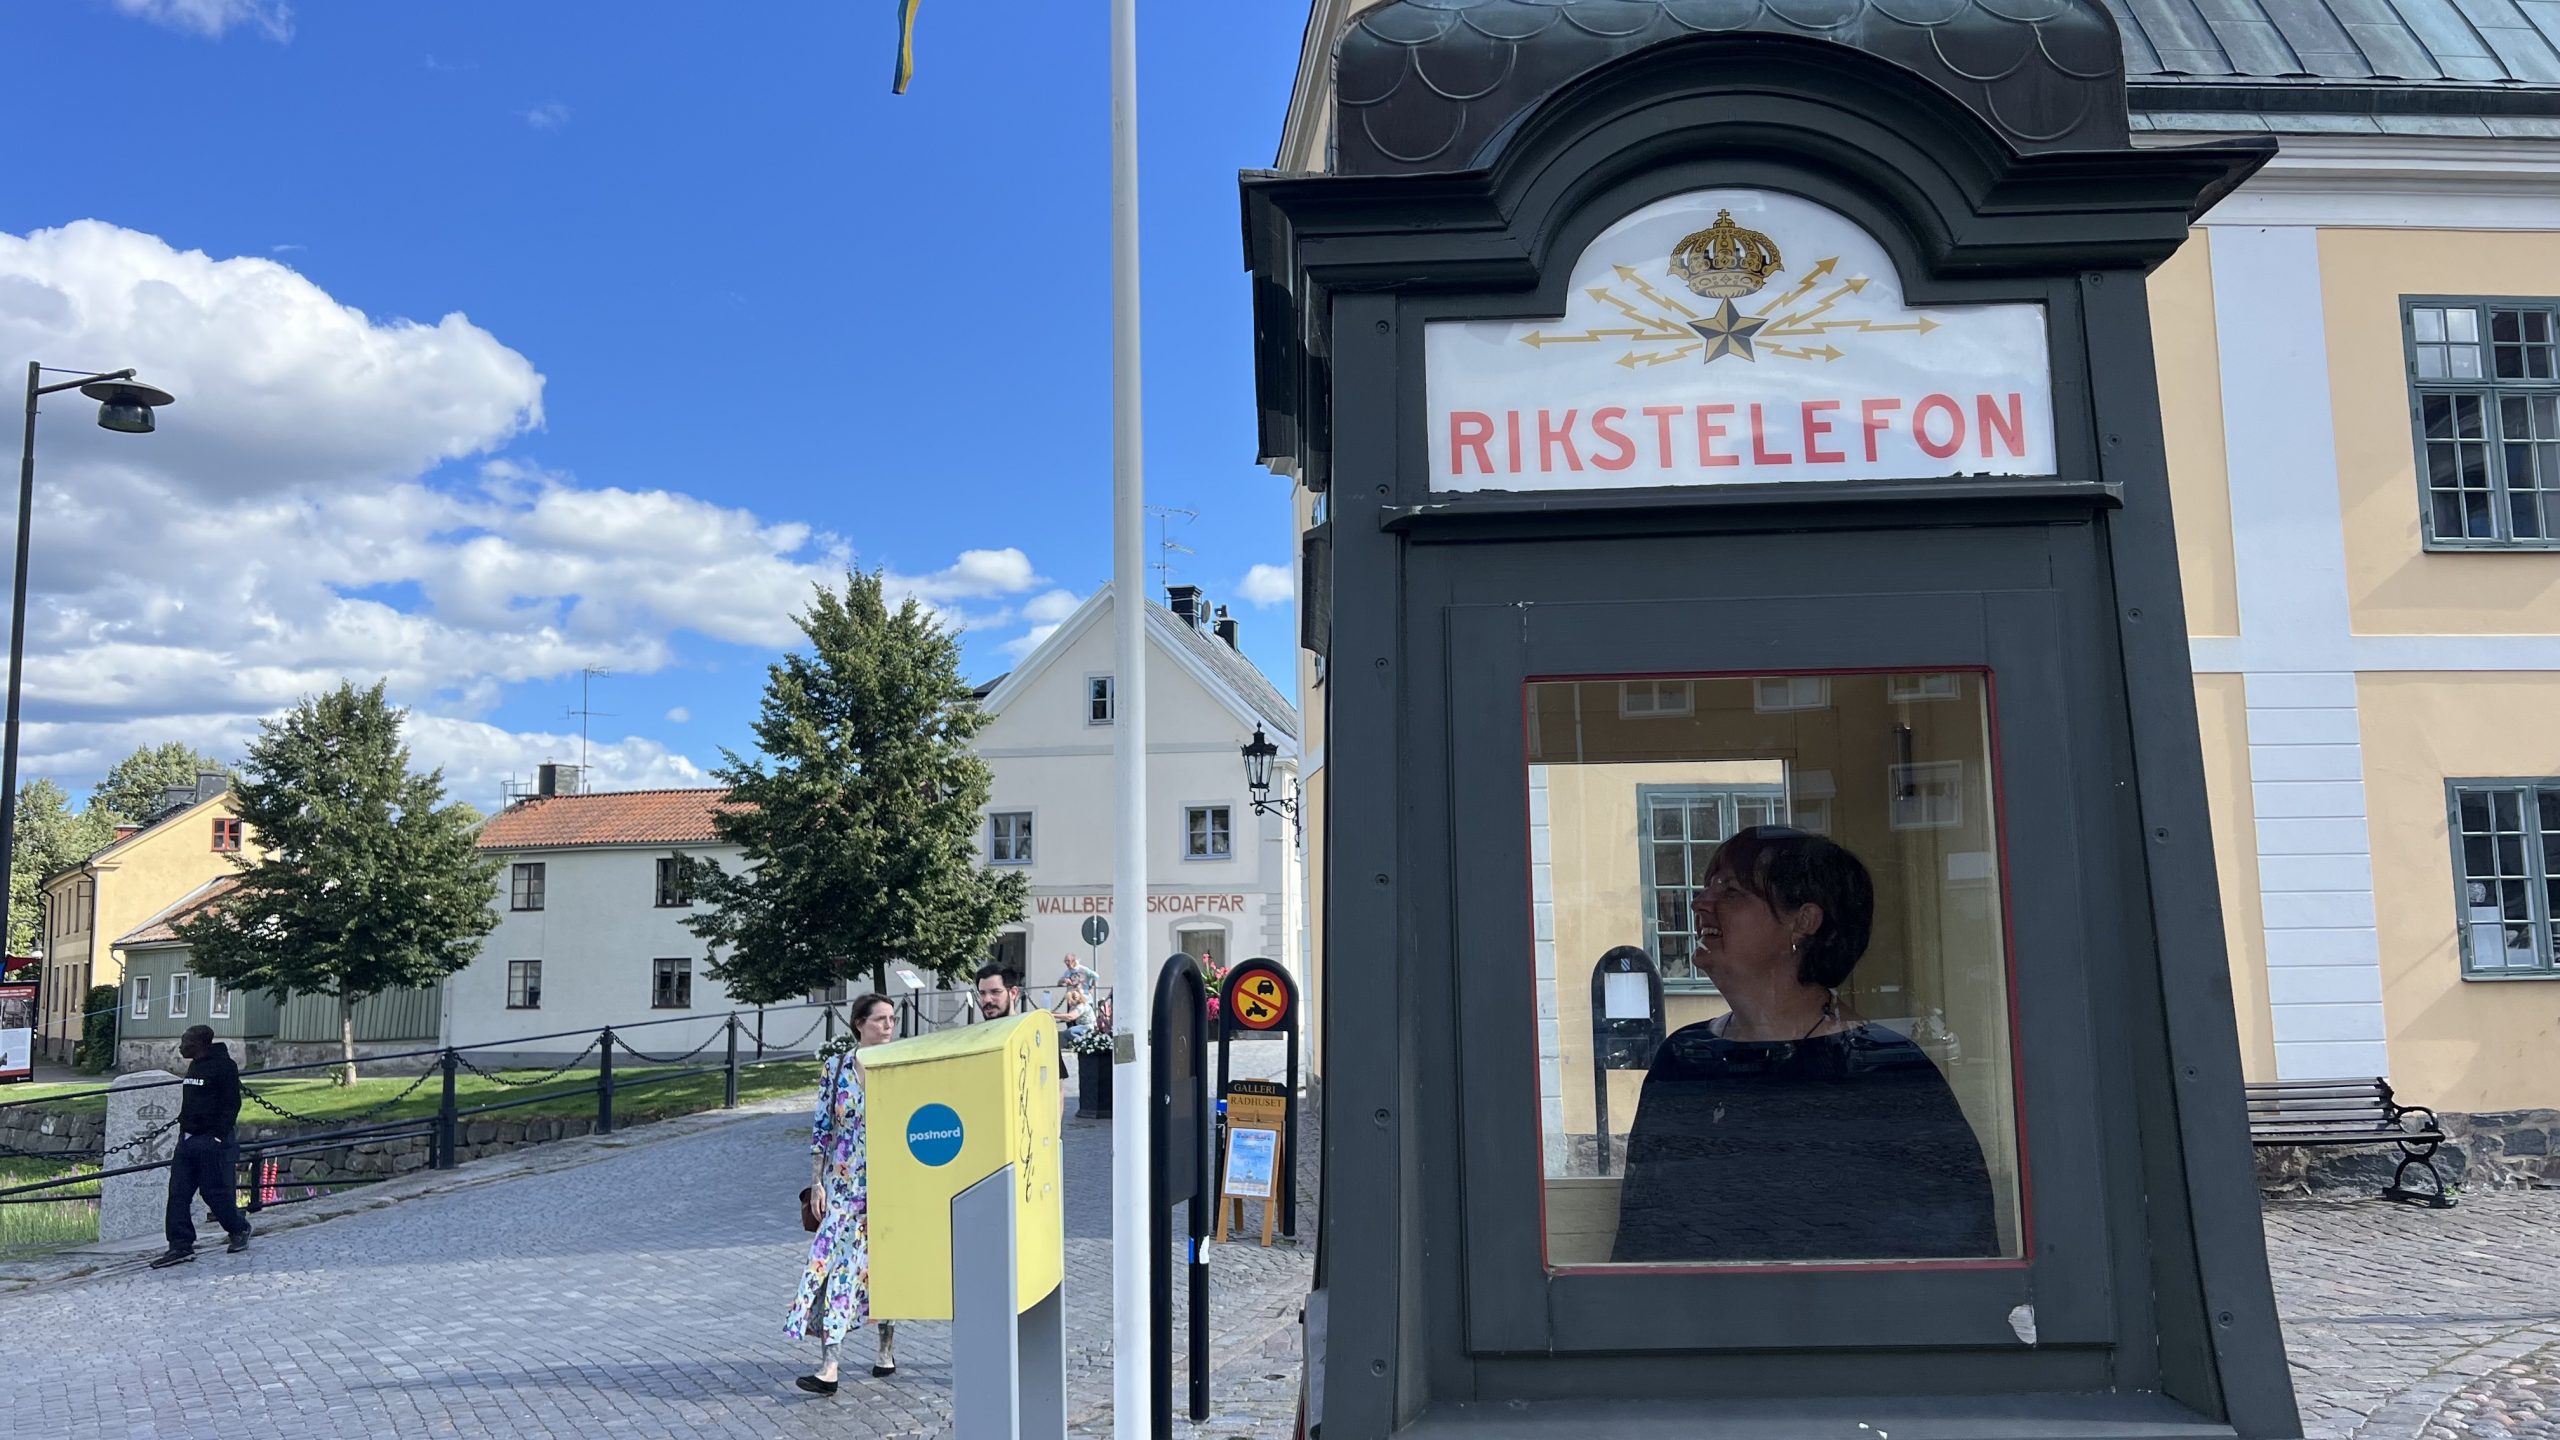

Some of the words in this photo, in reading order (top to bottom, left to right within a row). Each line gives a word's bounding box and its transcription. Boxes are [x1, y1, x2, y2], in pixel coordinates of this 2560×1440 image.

[1449, 393, 2026, 475] RIKSTELEFON
[1147, 893, 1244, 913] SKOAFFÄR
[1233, 1083, 1276, 1094] GALLERI
[909, 1126, 961, 1144] postnord
